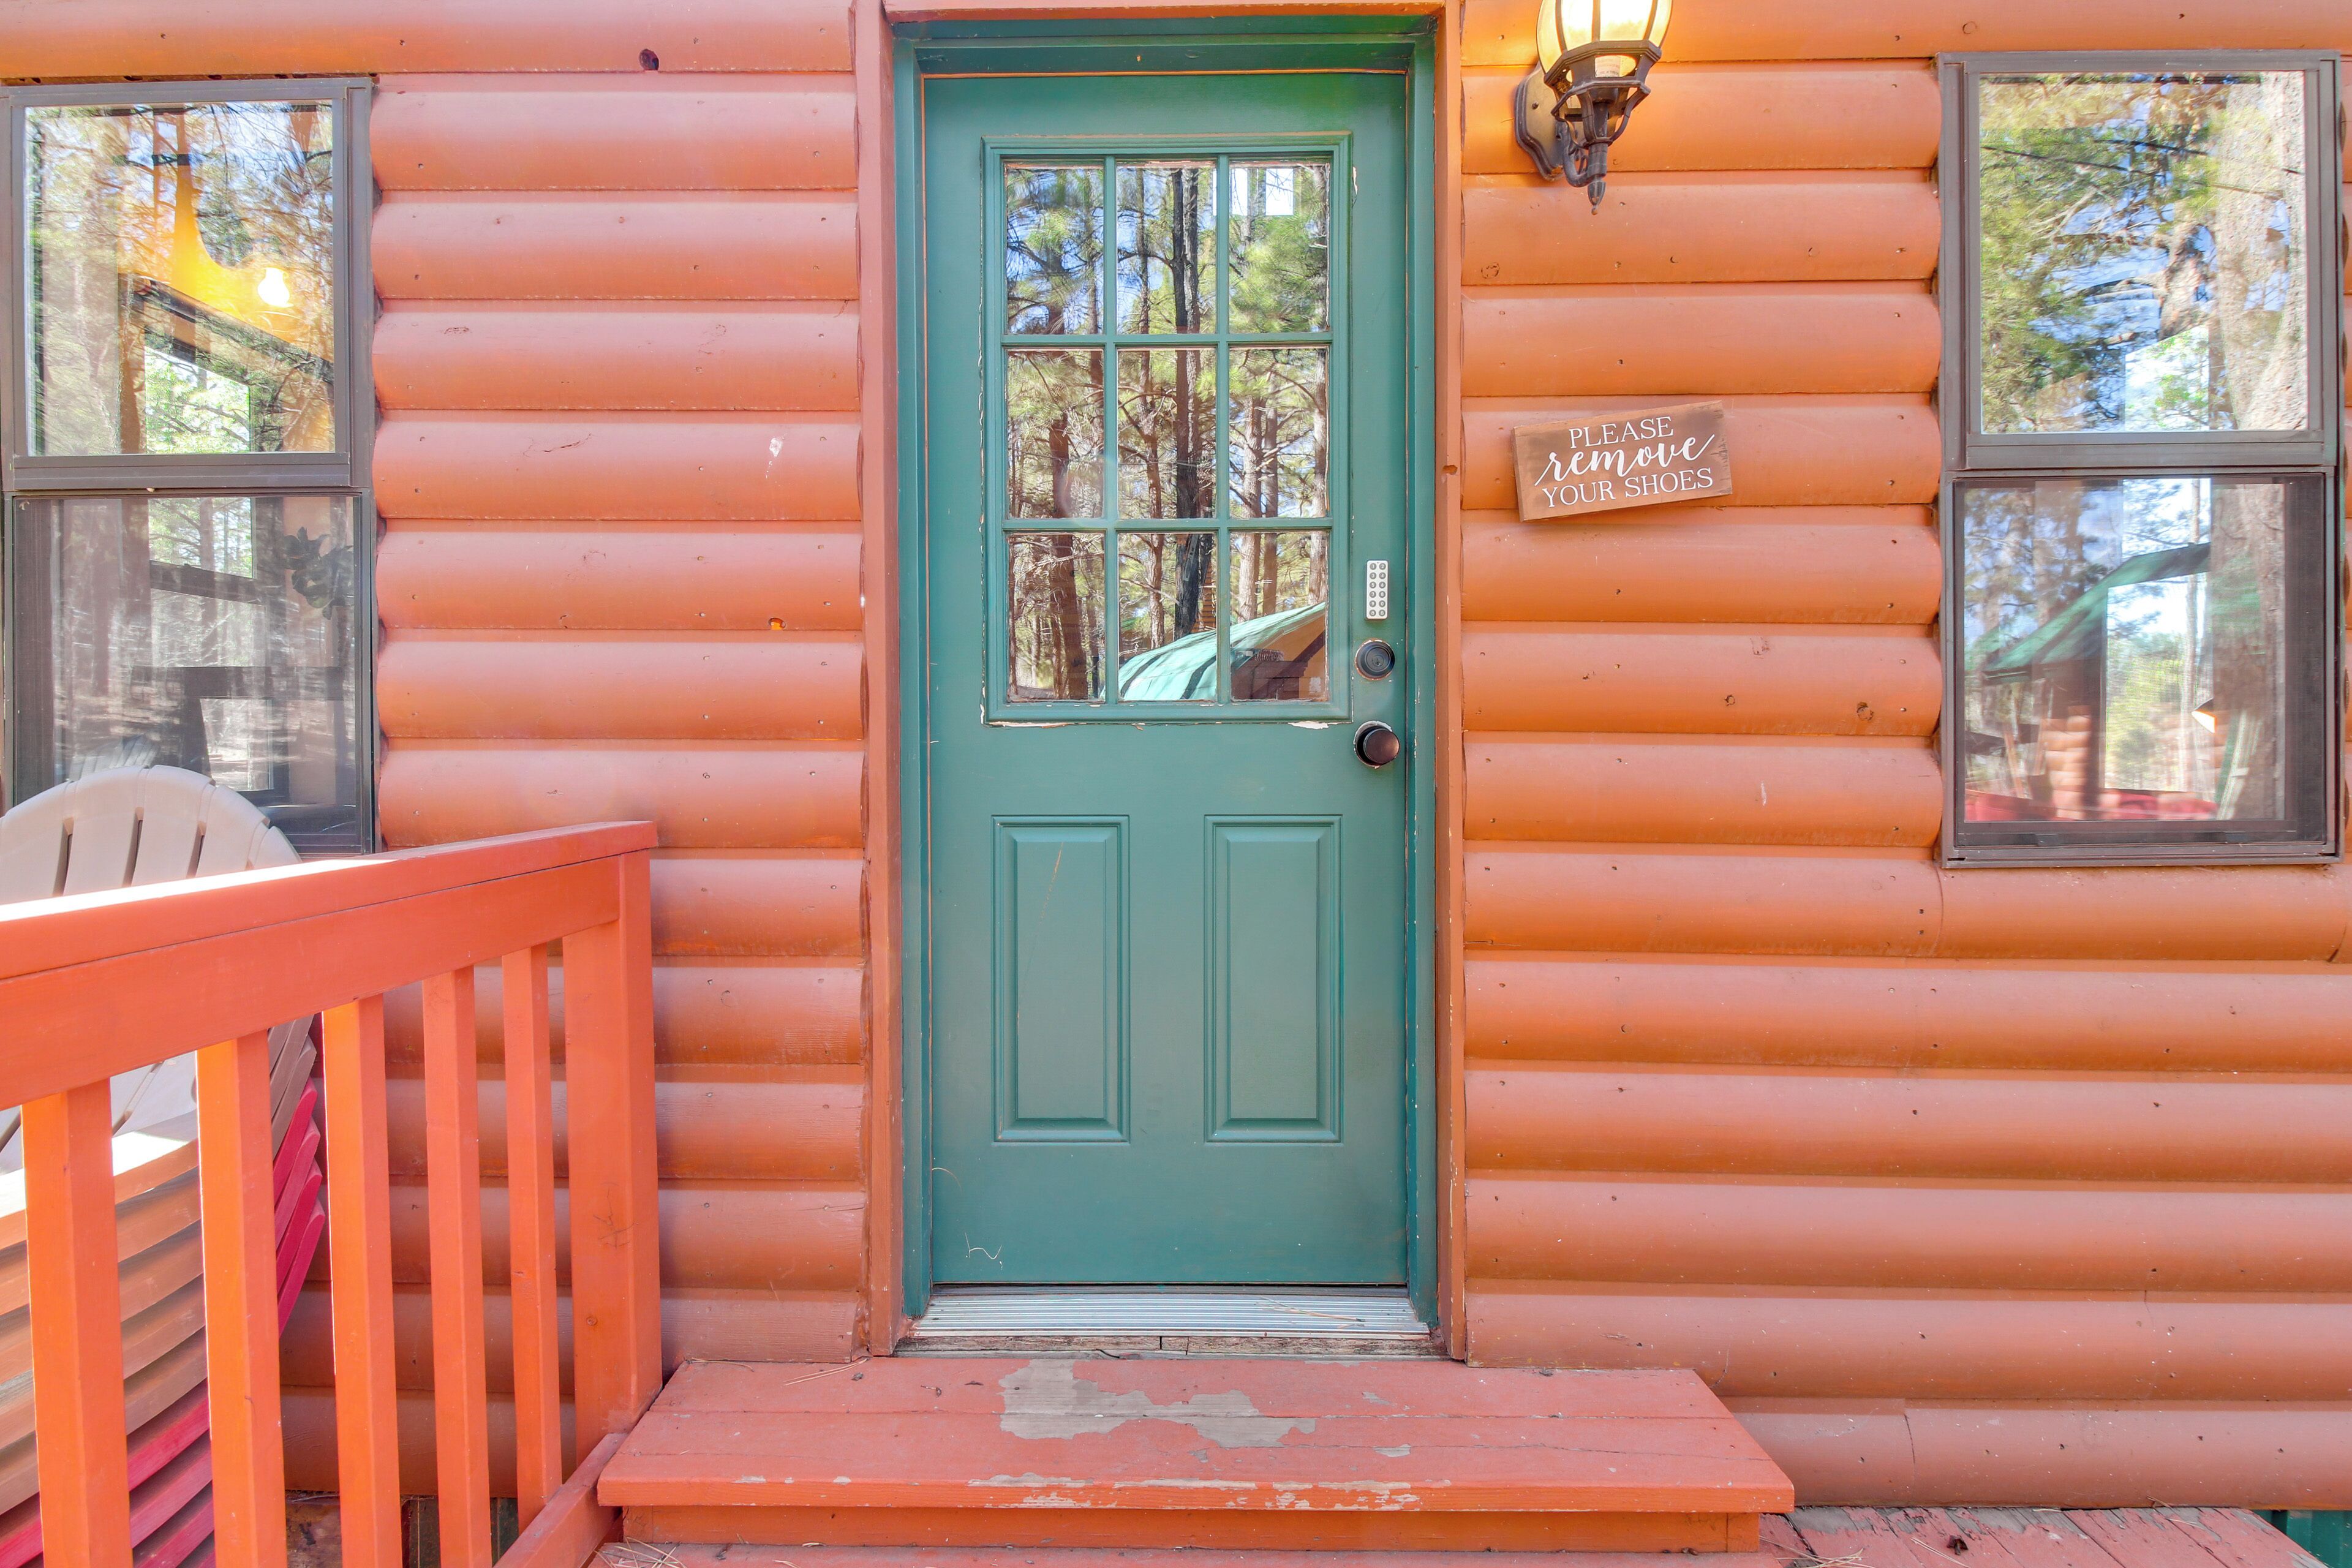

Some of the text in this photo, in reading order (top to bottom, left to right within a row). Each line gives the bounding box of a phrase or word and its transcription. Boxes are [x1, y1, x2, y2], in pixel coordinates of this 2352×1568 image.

[1569, 416, 1674, 449] PLEASE
[1534, 434, 1715, 486] remove
[1542, 467, 1714, 508] YOUR SHOES
